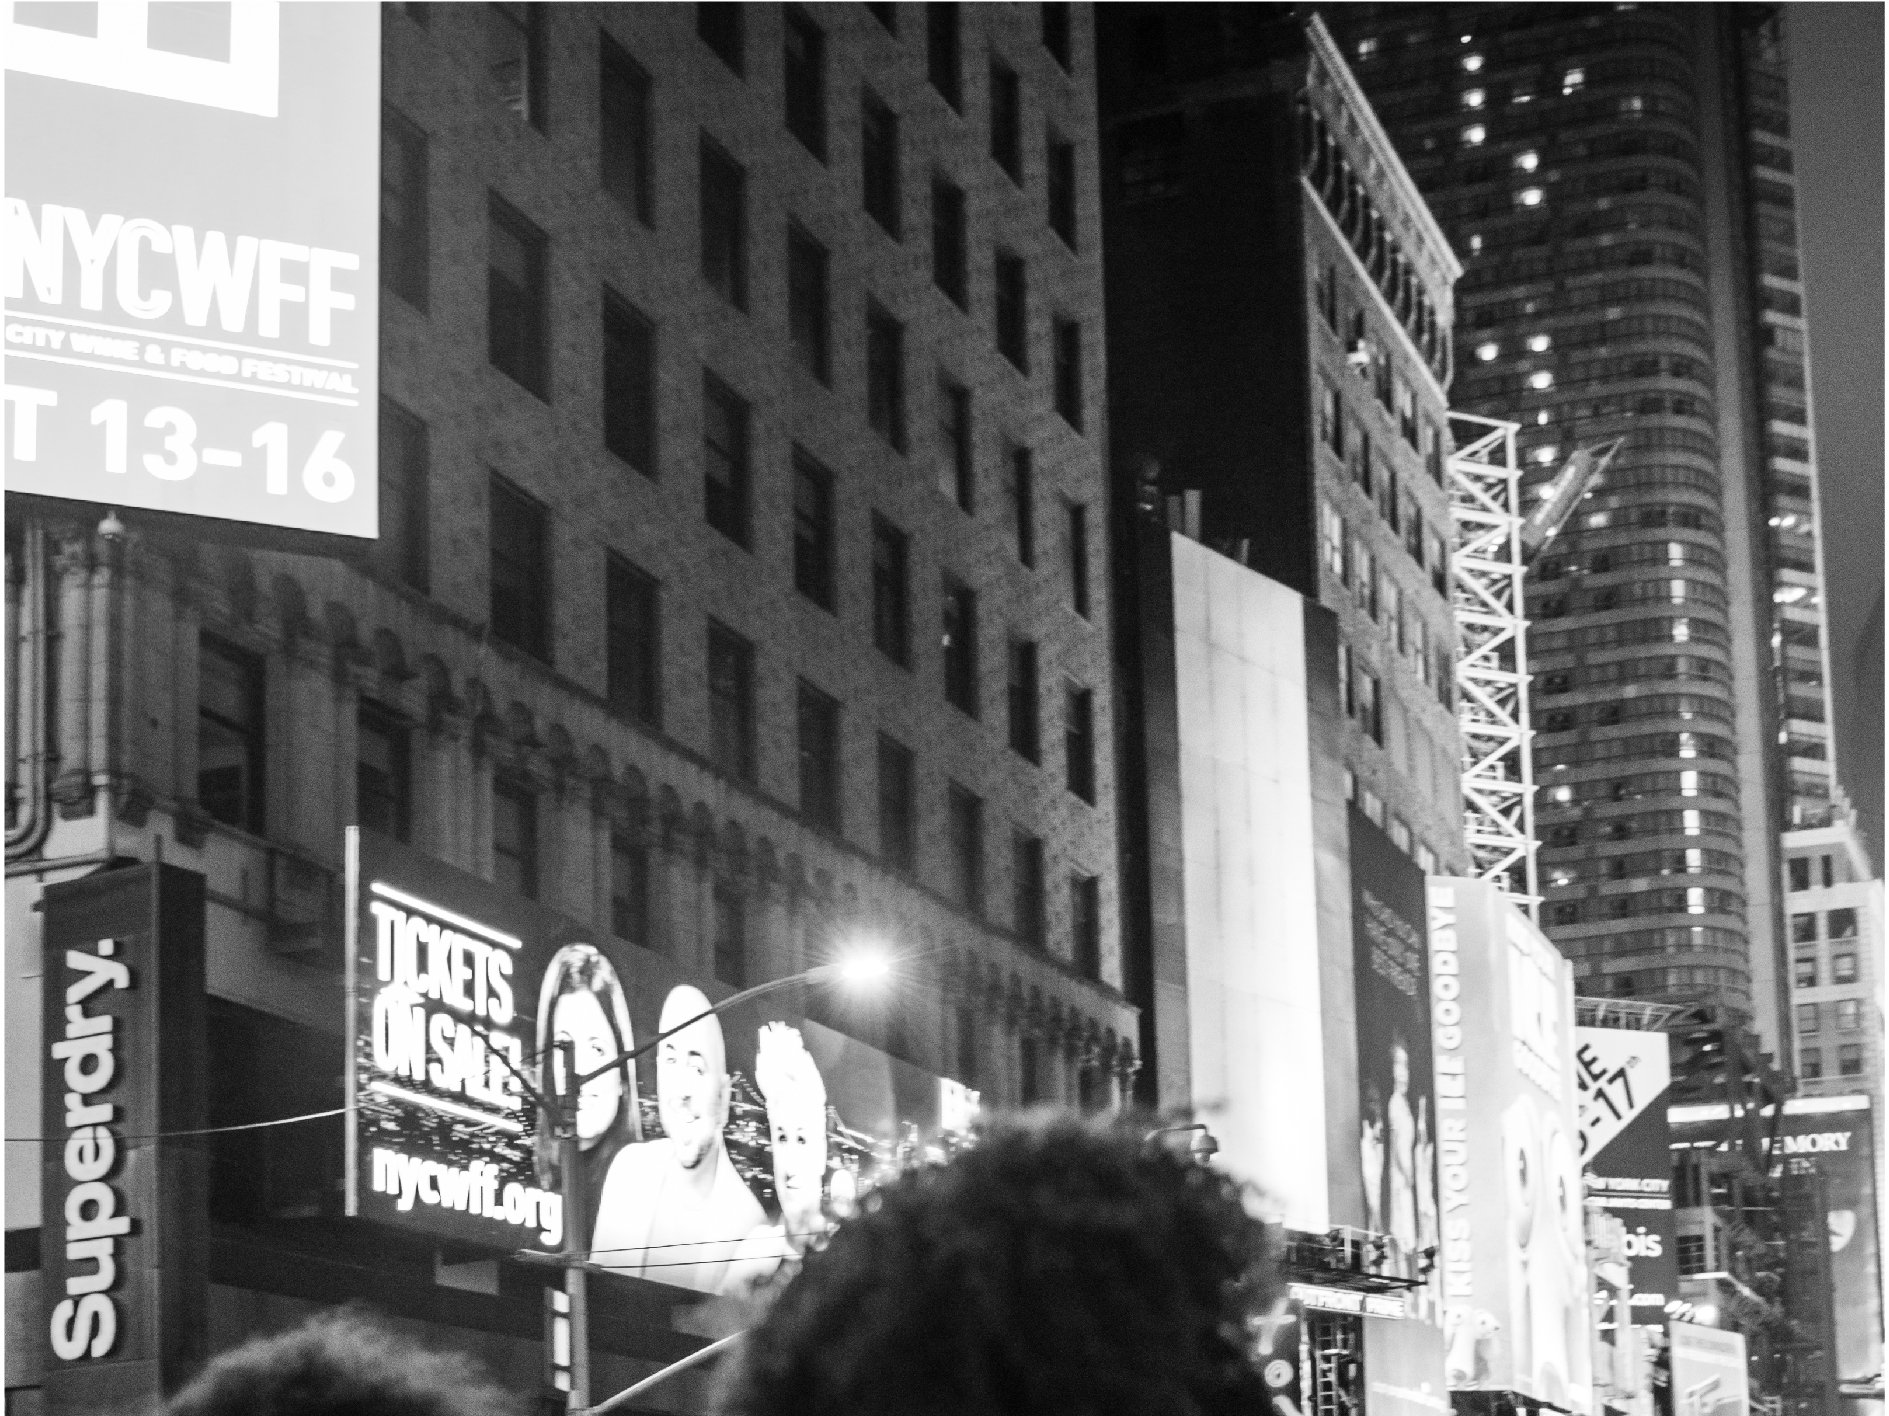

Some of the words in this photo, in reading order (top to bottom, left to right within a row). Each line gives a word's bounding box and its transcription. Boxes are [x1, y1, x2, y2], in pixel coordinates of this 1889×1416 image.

[4, 196, 360, 347] NYCWFF
[5, 323, 66, 350] CITY
[69, 331, 140, 361] WINE
[143, 343, 165, 365] &
[170, 347, 239, 376] FOOD
[241, 358, 360, 395] FESTIVAL
[90, 398, 356, 504] 13-16
[369, 900, 514, 1025] TICKETS
[1427, 886, 1461, 1050] GOODBYE
[373, 993, 427, 1082] ON
[429, 1012, 523, 1111] SALE!
[50, 937, 131, 1362] Superdry.
[373, 1147, 563, 1246] nycwff.org
[1443, 1117, 1470, 1214] YOUR
[1447, 1218, 1472, 1297] KISS
